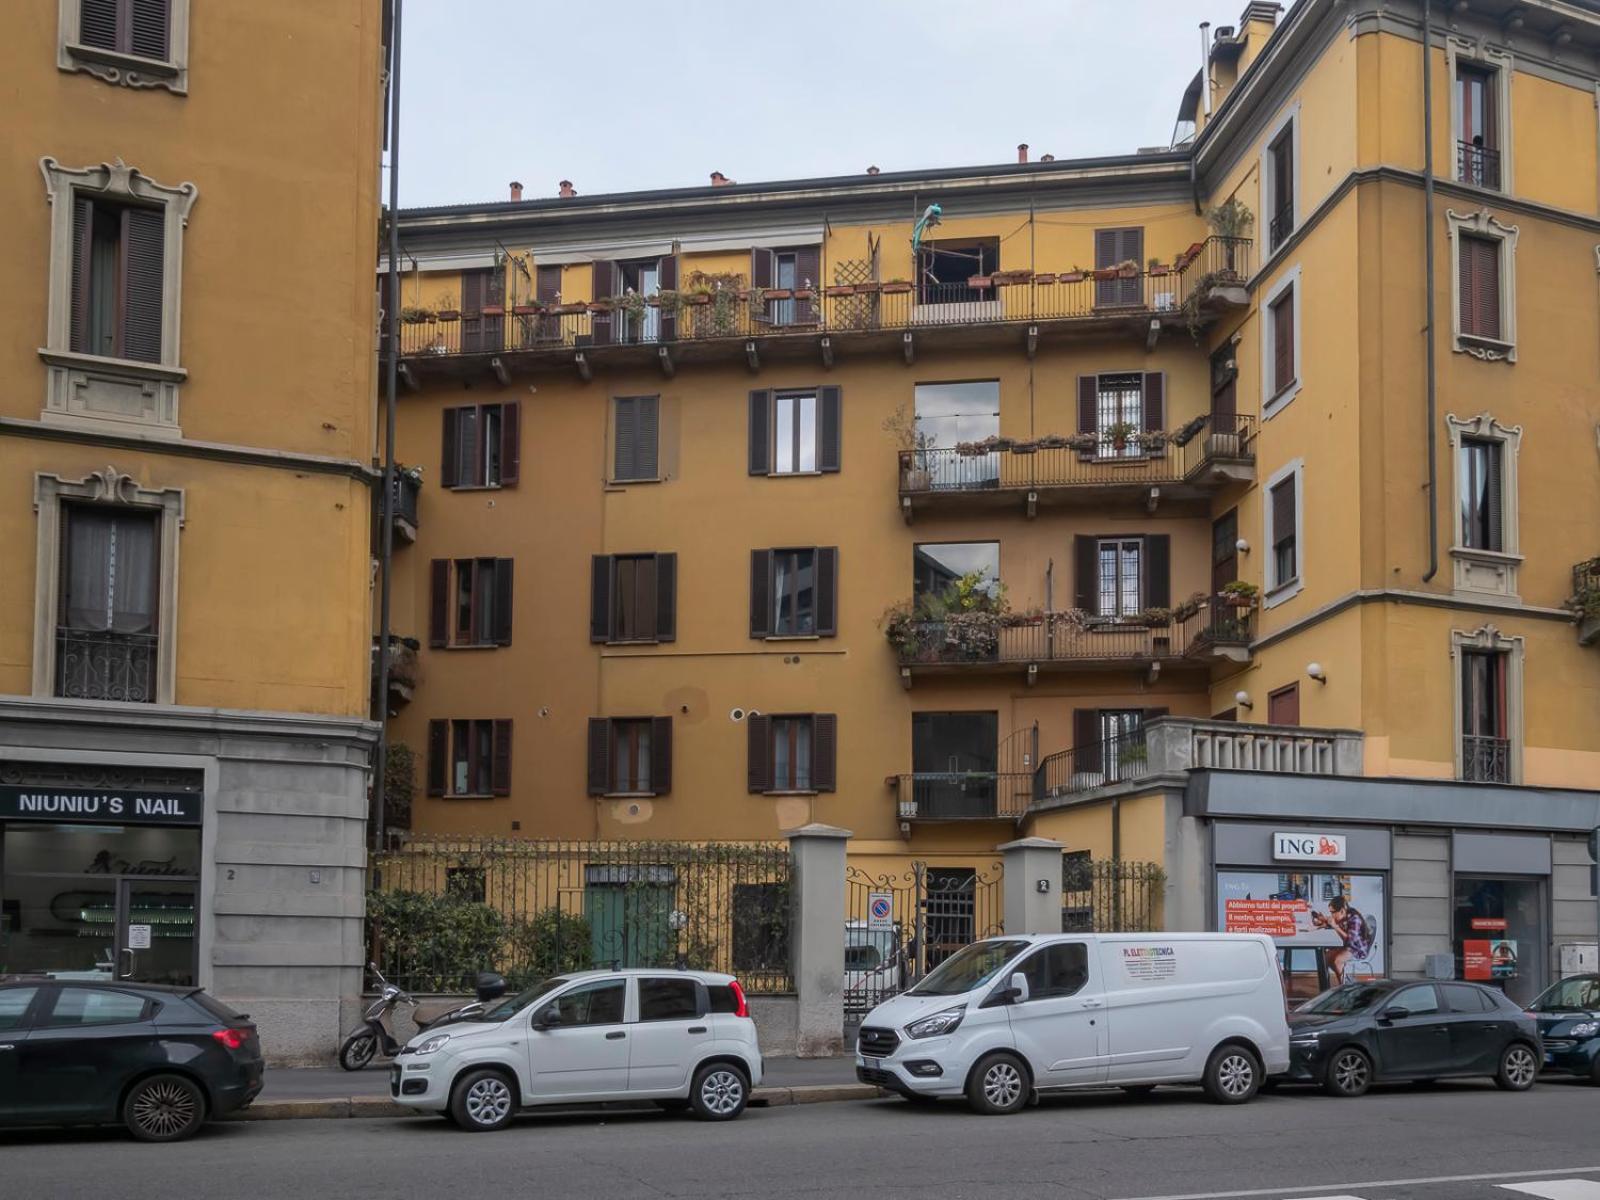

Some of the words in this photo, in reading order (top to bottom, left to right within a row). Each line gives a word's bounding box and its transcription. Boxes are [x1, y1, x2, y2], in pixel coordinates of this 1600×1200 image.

[20, 794, 124, 814] NIUNIU'S
[135, 798, 185, 816] NAIL
[1280, 839, 1315, 855] ING
[227, 869, 235, 880] 2
[1229, 901, 1255, 909] Abbiamo
